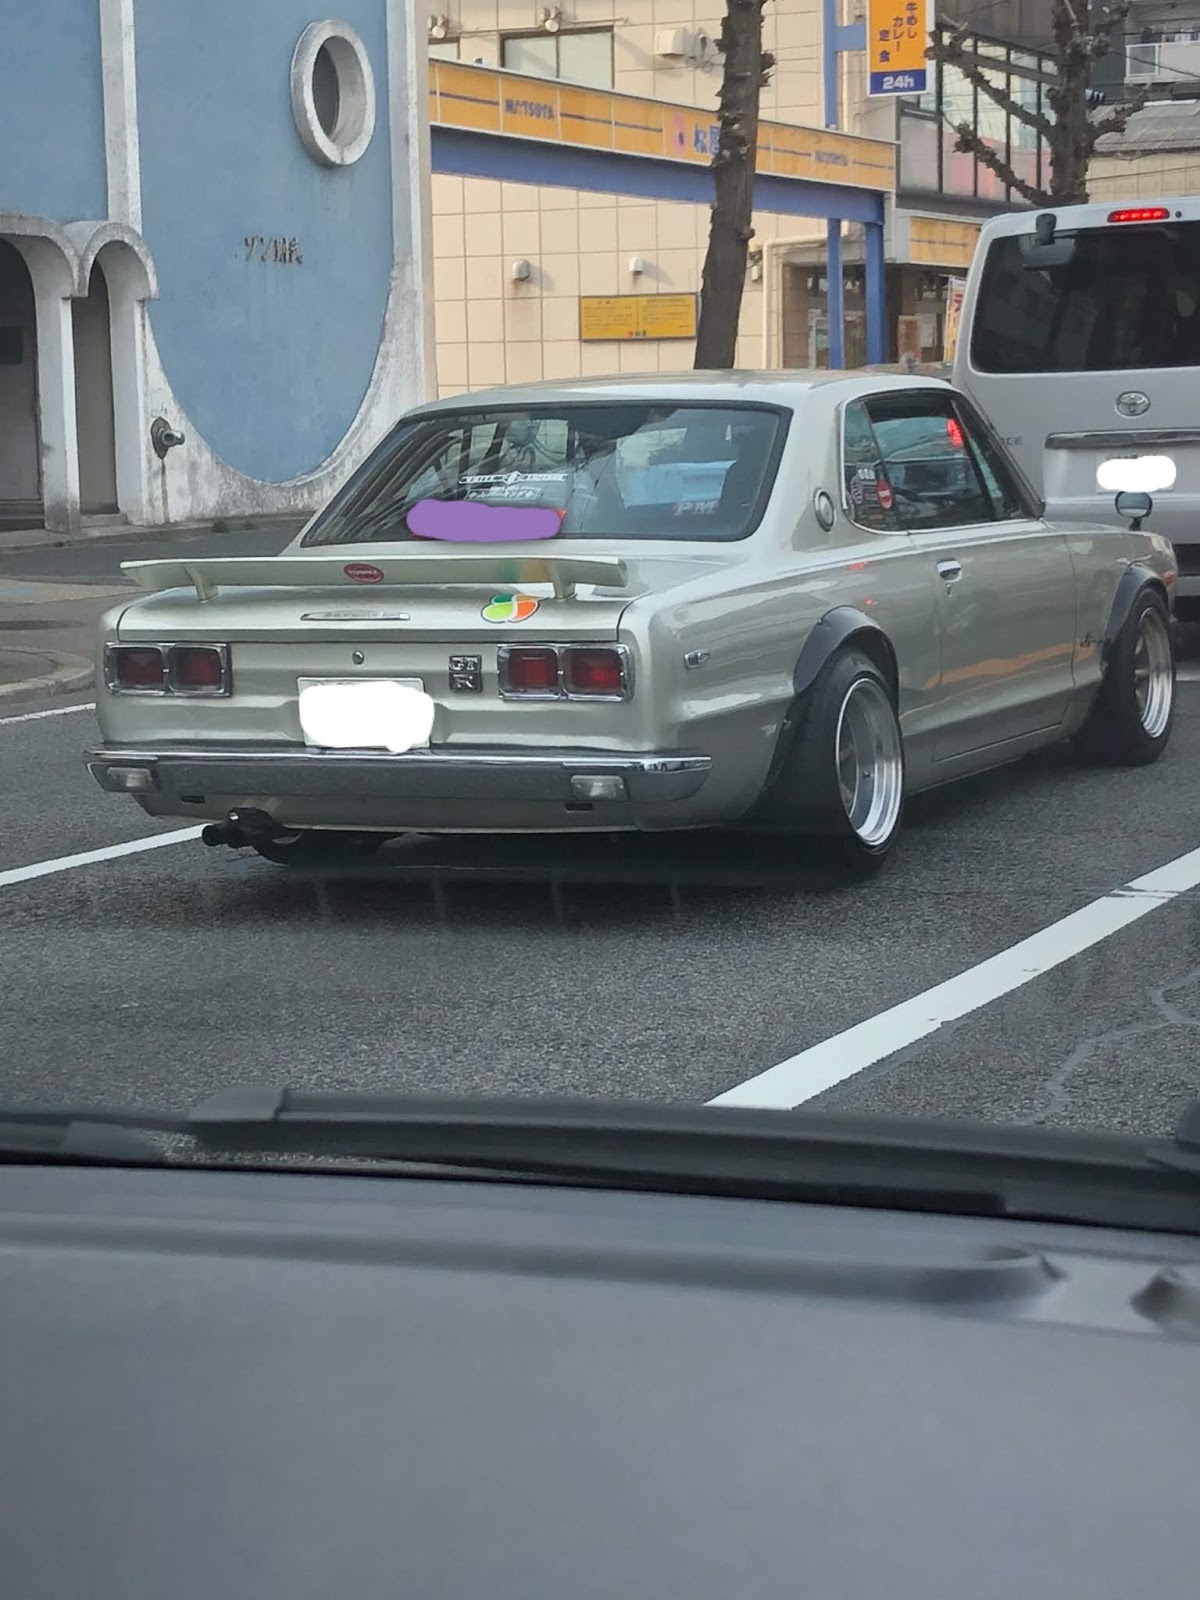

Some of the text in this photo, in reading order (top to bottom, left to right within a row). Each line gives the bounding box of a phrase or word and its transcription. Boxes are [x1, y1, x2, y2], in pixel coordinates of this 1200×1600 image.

[892, 15, 905, 53] カレー
[905, 1, 918, 39] 牛めし
[882, 75, 915, 90] 24h
